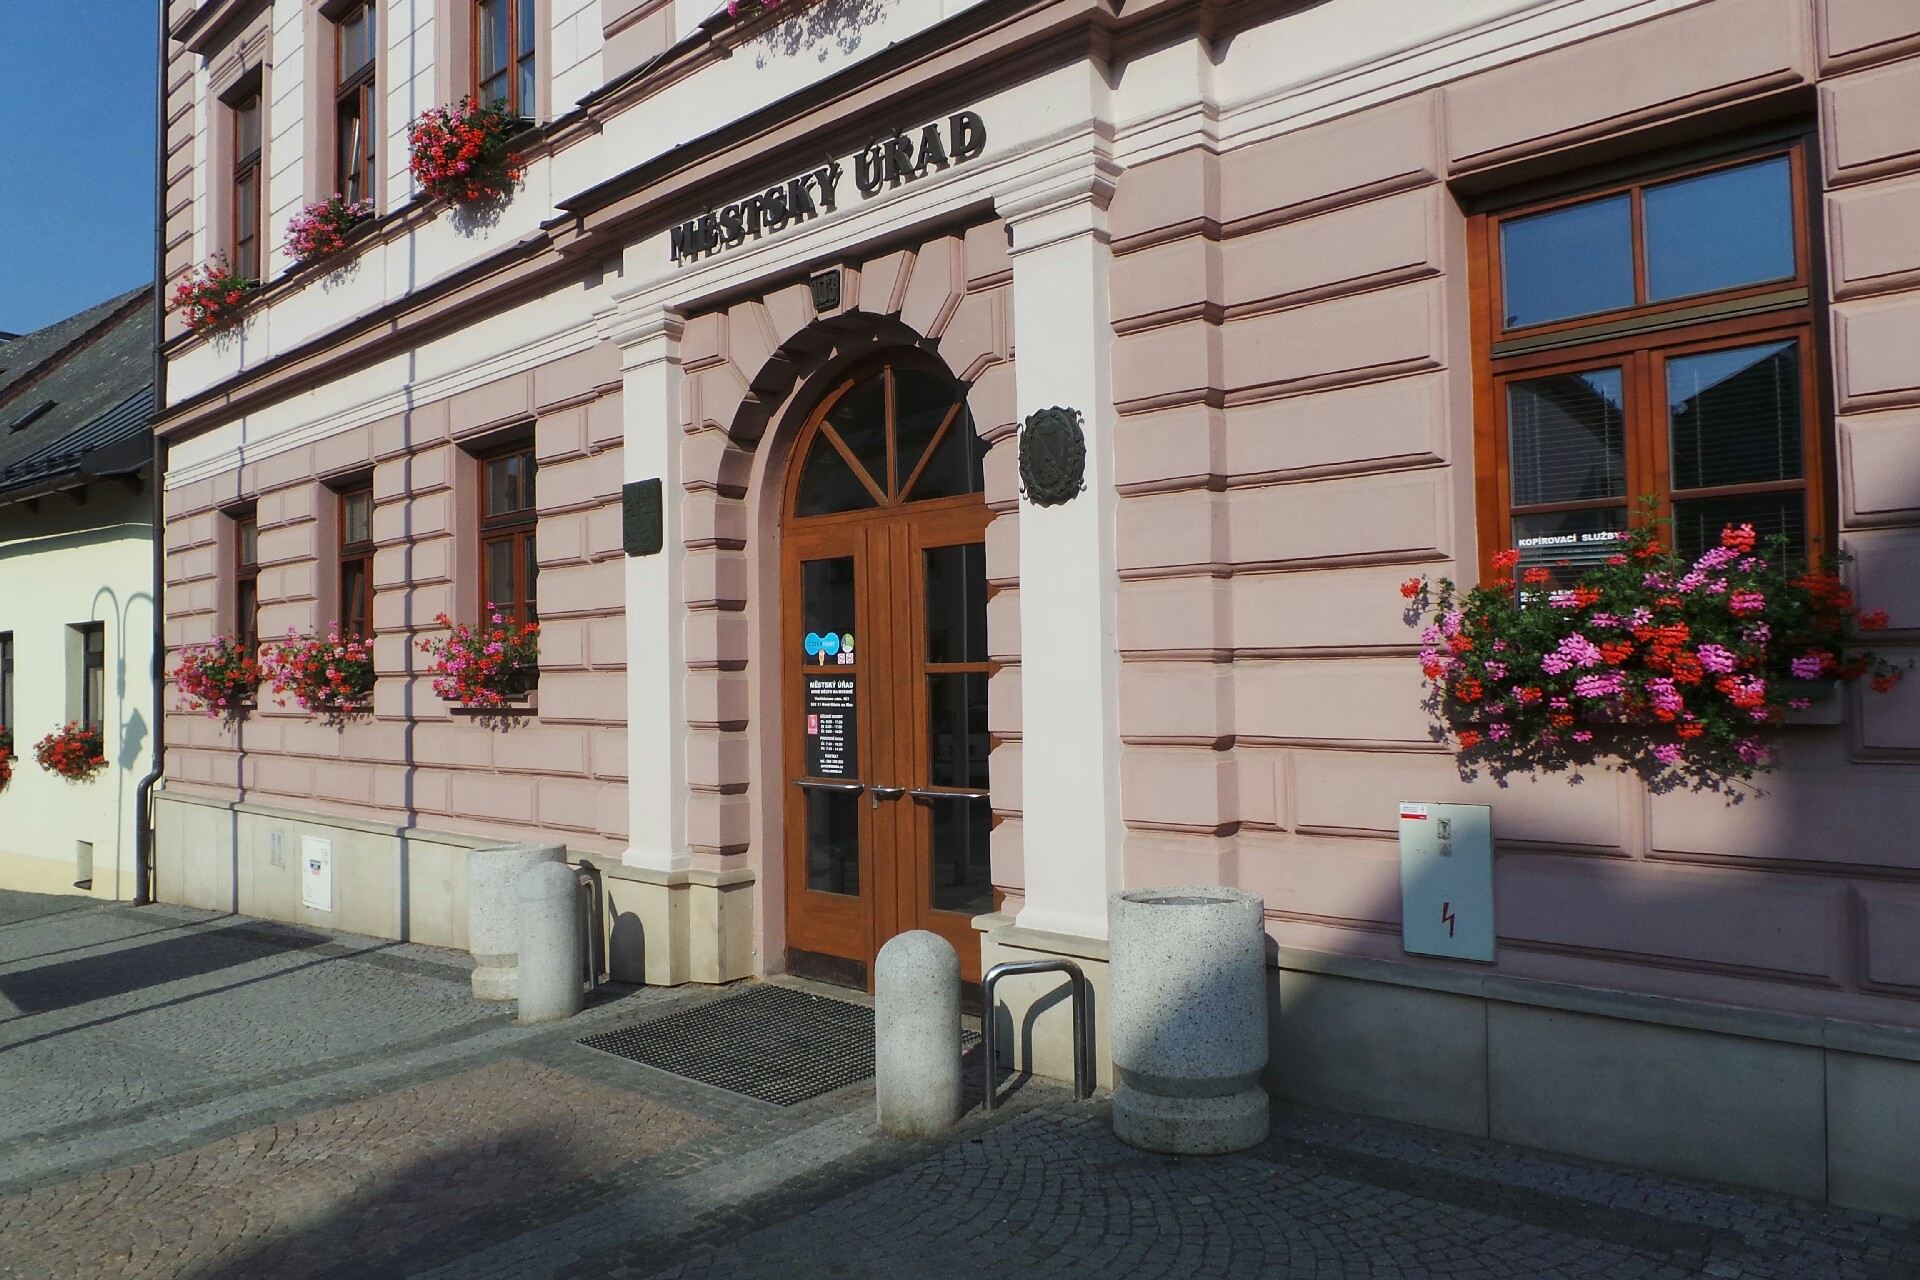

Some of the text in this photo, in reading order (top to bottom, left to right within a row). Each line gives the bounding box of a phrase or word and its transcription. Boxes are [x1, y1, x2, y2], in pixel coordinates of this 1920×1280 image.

[669, 110, 987, 263] MĚSTSKÝ ÚŘAD
[1518, 534, 1577, 546] KOPÍROVACÍ
[809, 680, 854, 689] MĚSTSKÝ ÚŘAD
